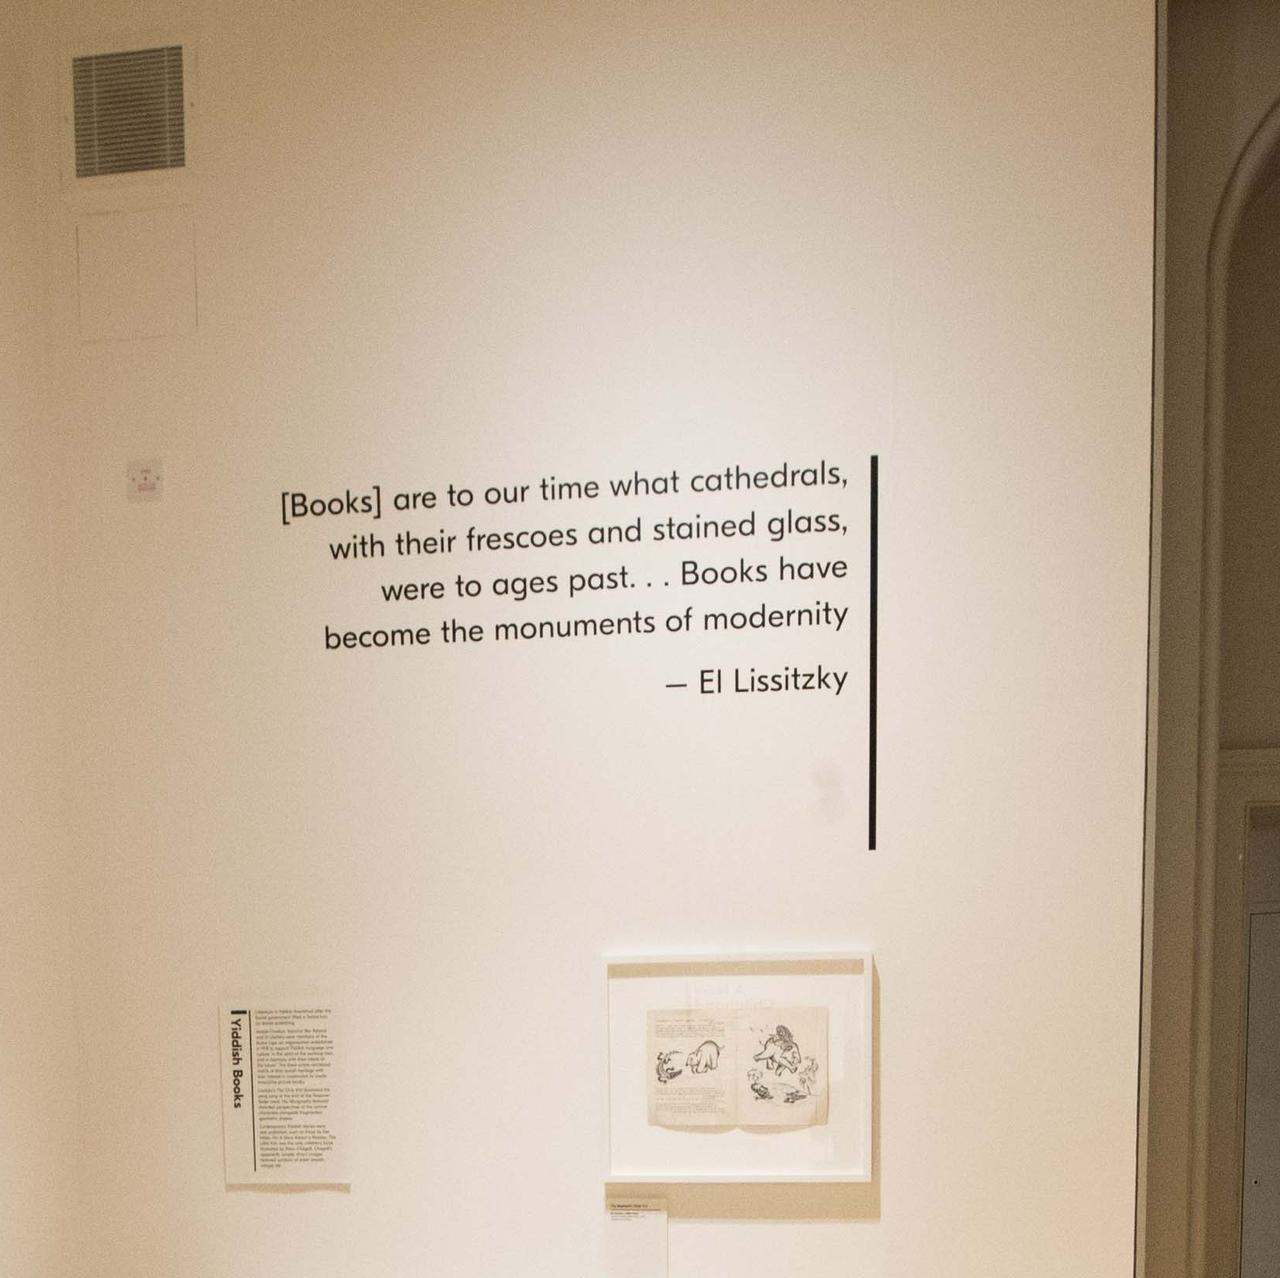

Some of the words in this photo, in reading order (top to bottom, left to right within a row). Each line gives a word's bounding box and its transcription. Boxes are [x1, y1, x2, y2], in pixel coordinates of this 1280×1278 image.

[281, 485, 381, 526] [Books]
[393, 491, 437, 511] are
[447, 484, 474, 507] to
[484, 485, 530, 505] our
[539, 476, 599, 501] time
[609, 470, 679, 497] what
[690, 459, 847, 493] cathedrals,
[329, 533, 385, 560] with
[395, 528, 457, 556] their
[466, 526, 578, 552] frescoes
[588, 517, 641, 545] and
[653, 510, 755, 541] stained
[767, 508, 847, 542] glass,
[381, 581, 445, 602] were
[455, 574, 482, 598] to
[492, 575, 559, 602] ages
[681, 557, 768, 586] Books
[779, 555, 848, 581] have
[324, 625, 431, 650] become
[440, 618, 484, 644] the
[495, 610, 656, 641] monuments
[665, 606, 693, 633] of
[704, 600, 849, 632] modernity
[700, 669, 722, 695] El
[734, 664, 848, 696] Lissitzky
[230, 1018, 243, 1066] Yiddish
[232, 1069, 245, 1109] Books
